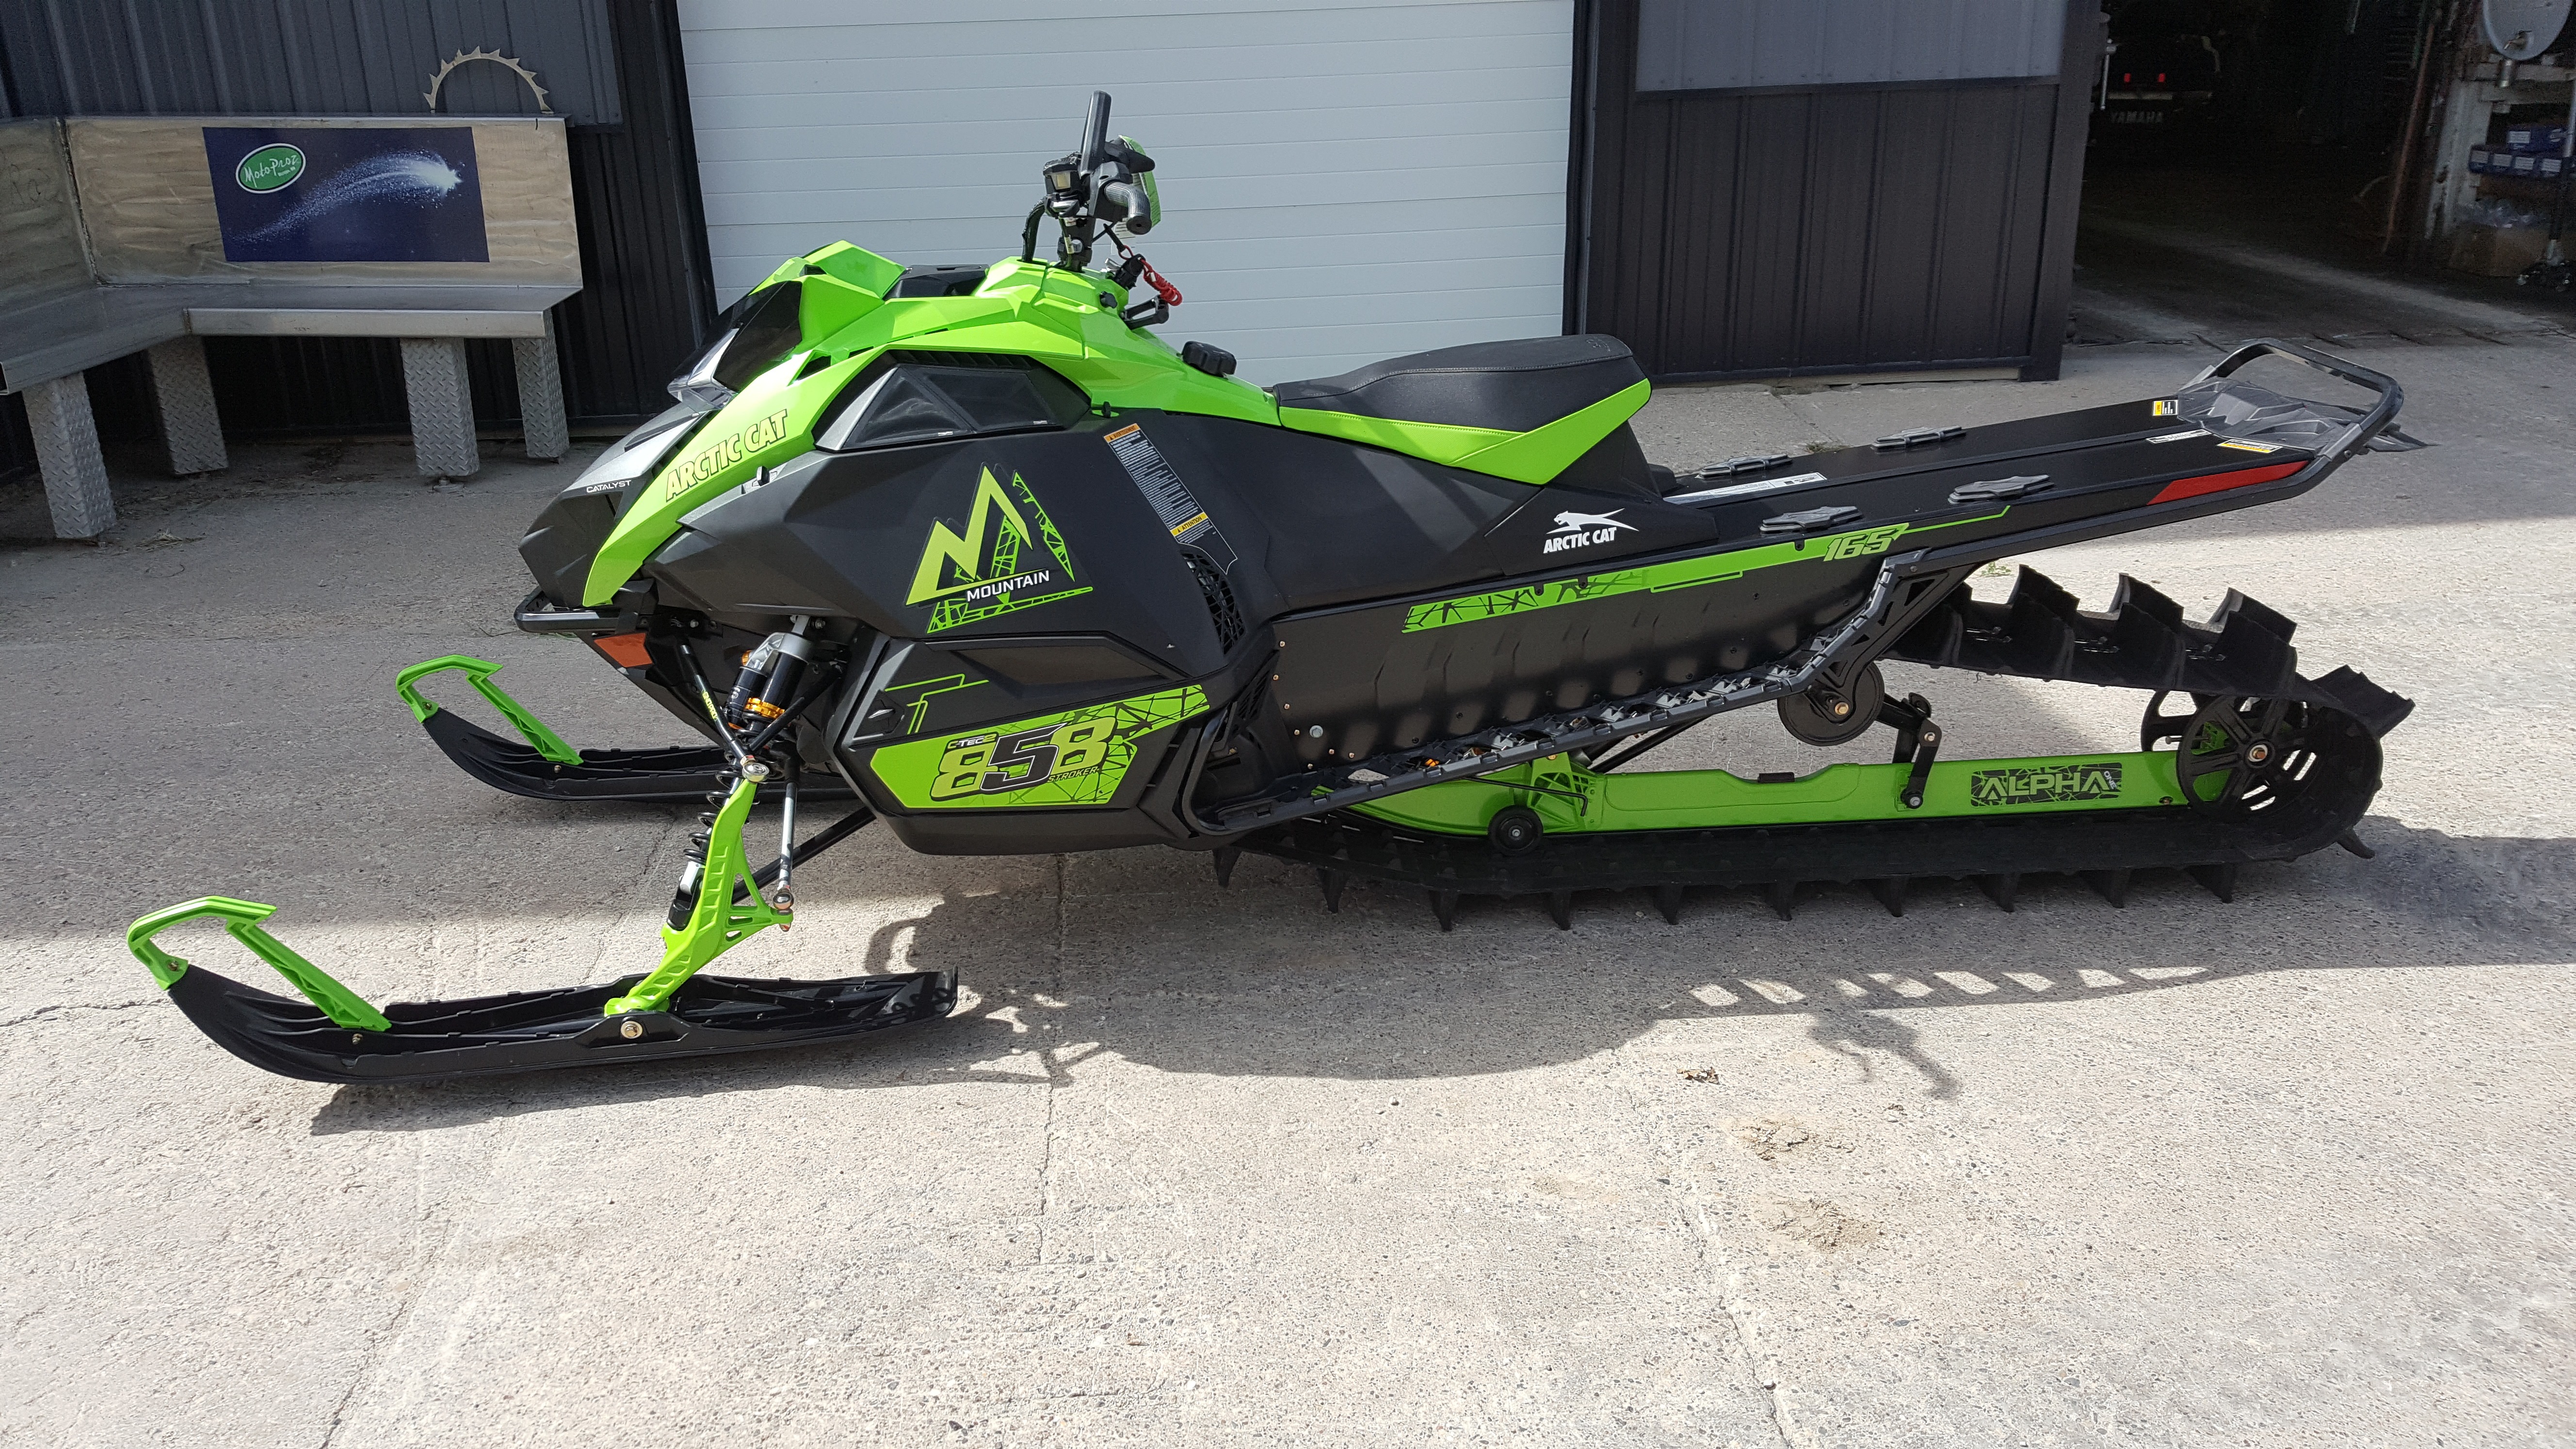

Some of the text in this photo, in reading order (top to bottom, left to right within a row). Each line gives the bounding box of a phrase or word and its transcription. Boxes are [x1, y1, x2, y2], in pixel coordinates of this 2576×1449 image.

[666, 409, 788, 502] ARCTIC CAT
[586, 480, 631, 493] CATALYST
[1181, 515, 1203, 531] ATTENTION
[1543, 527, 1617, 554] ARCTIC CAT
[1823, 529, 1897, 562] 165
[966, 570, 1049, 602] MOUNTAIN
[947, 733, 997, 749] C-TEC2
[930, 716, 1117, 800] 858
[1047, 766, 1098, 783] STROKER
[1978, 771, 2118, 800] ALPHA ONE
